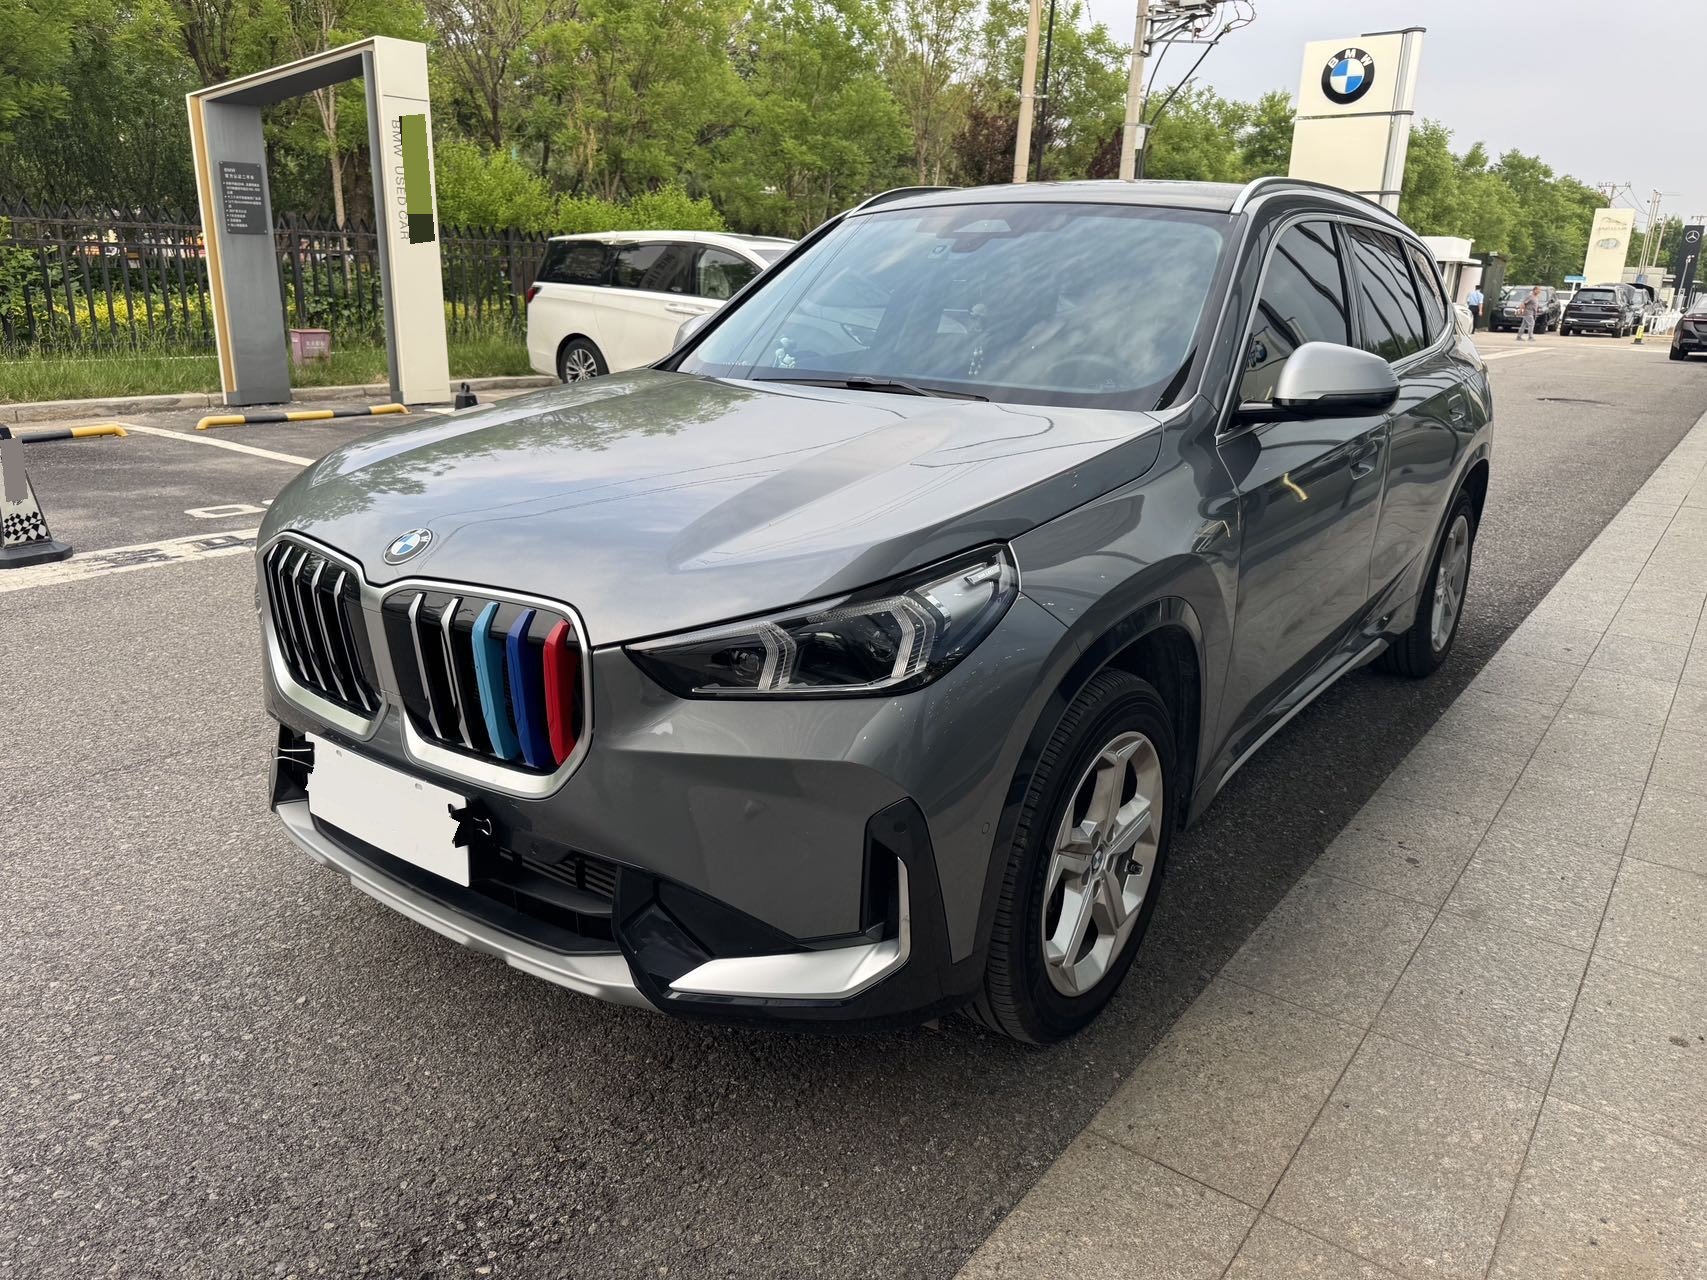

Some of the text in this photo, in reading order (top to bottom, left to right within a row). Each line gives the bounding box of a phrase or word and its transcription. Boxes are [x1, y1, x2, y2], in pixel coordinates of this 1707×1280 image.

[1328, 49, 1373, 69] BMW
[391, 119, 410, 240] BMW USED CAR
